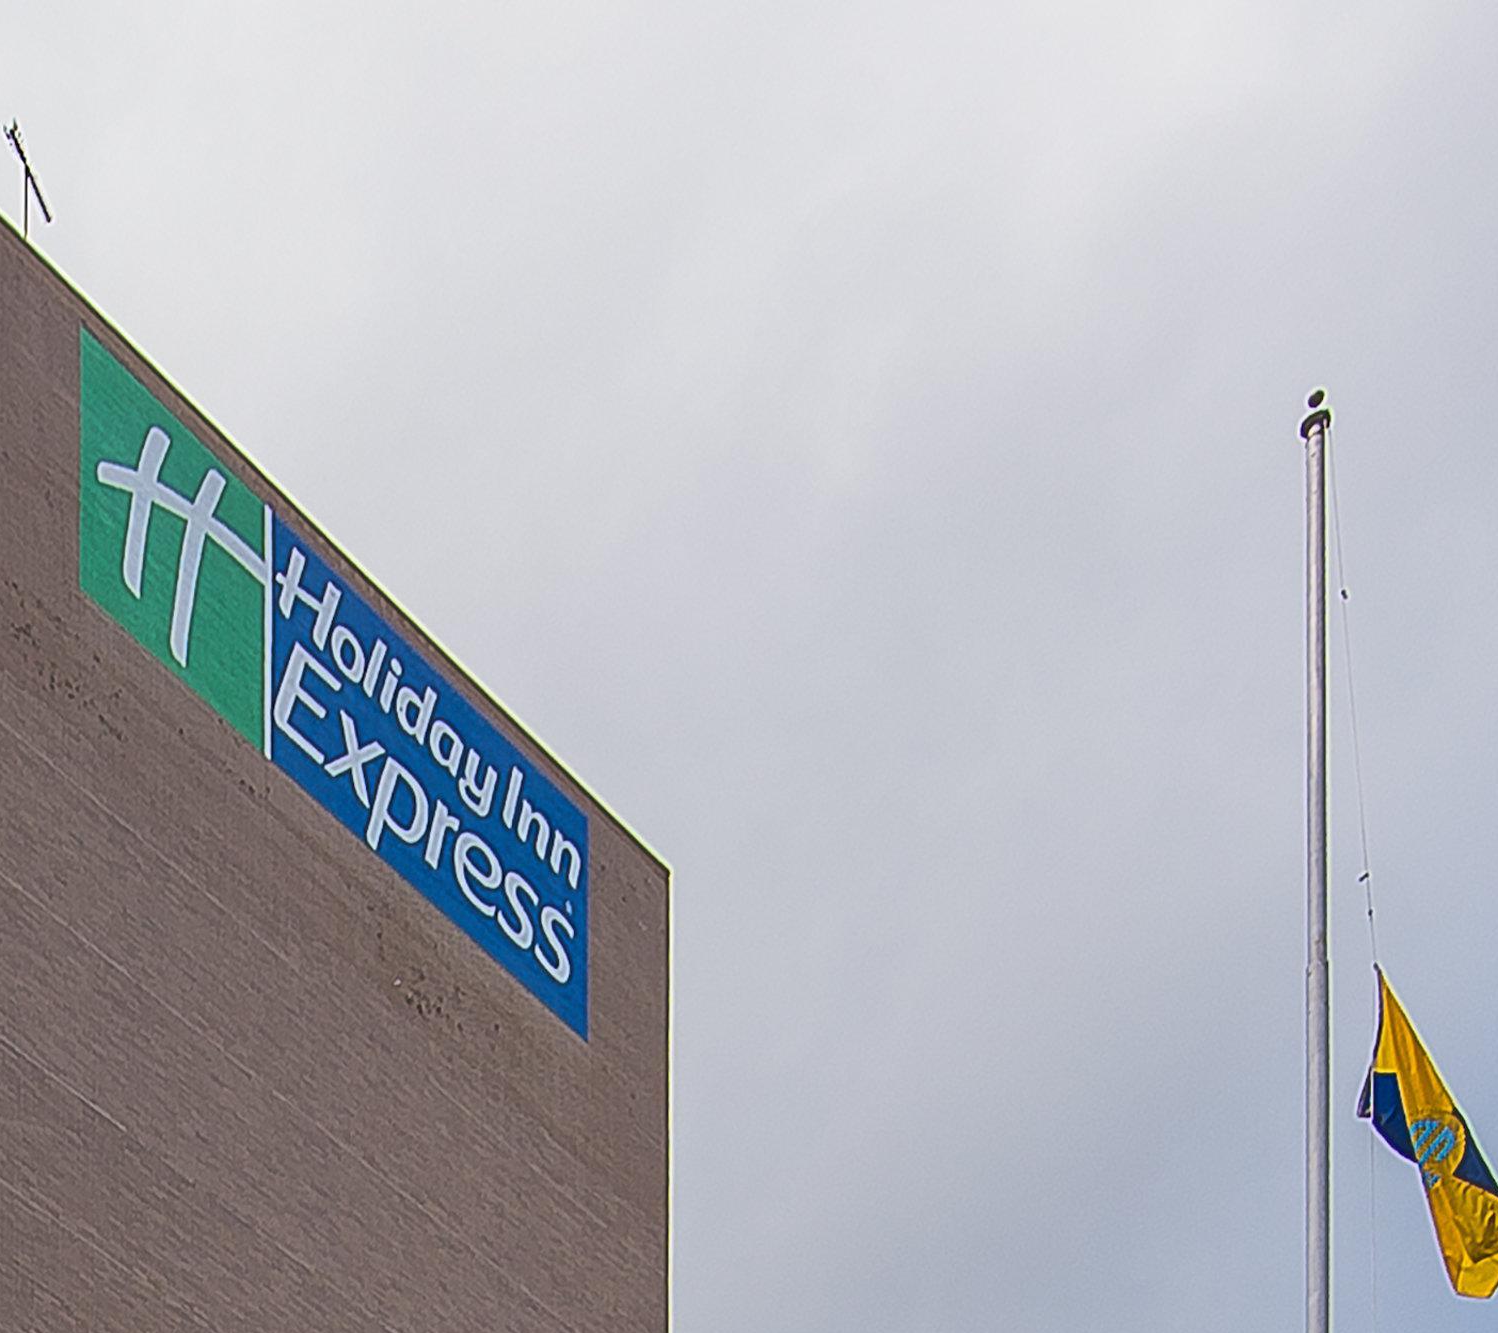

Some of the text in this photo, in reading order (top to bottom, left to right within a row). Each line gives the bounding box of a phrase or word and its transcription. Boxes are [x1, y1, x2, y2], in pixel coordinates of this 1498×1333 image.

[274, 641, 577, 986] Express
[275, 546, 581, 890] Holiday Inn
